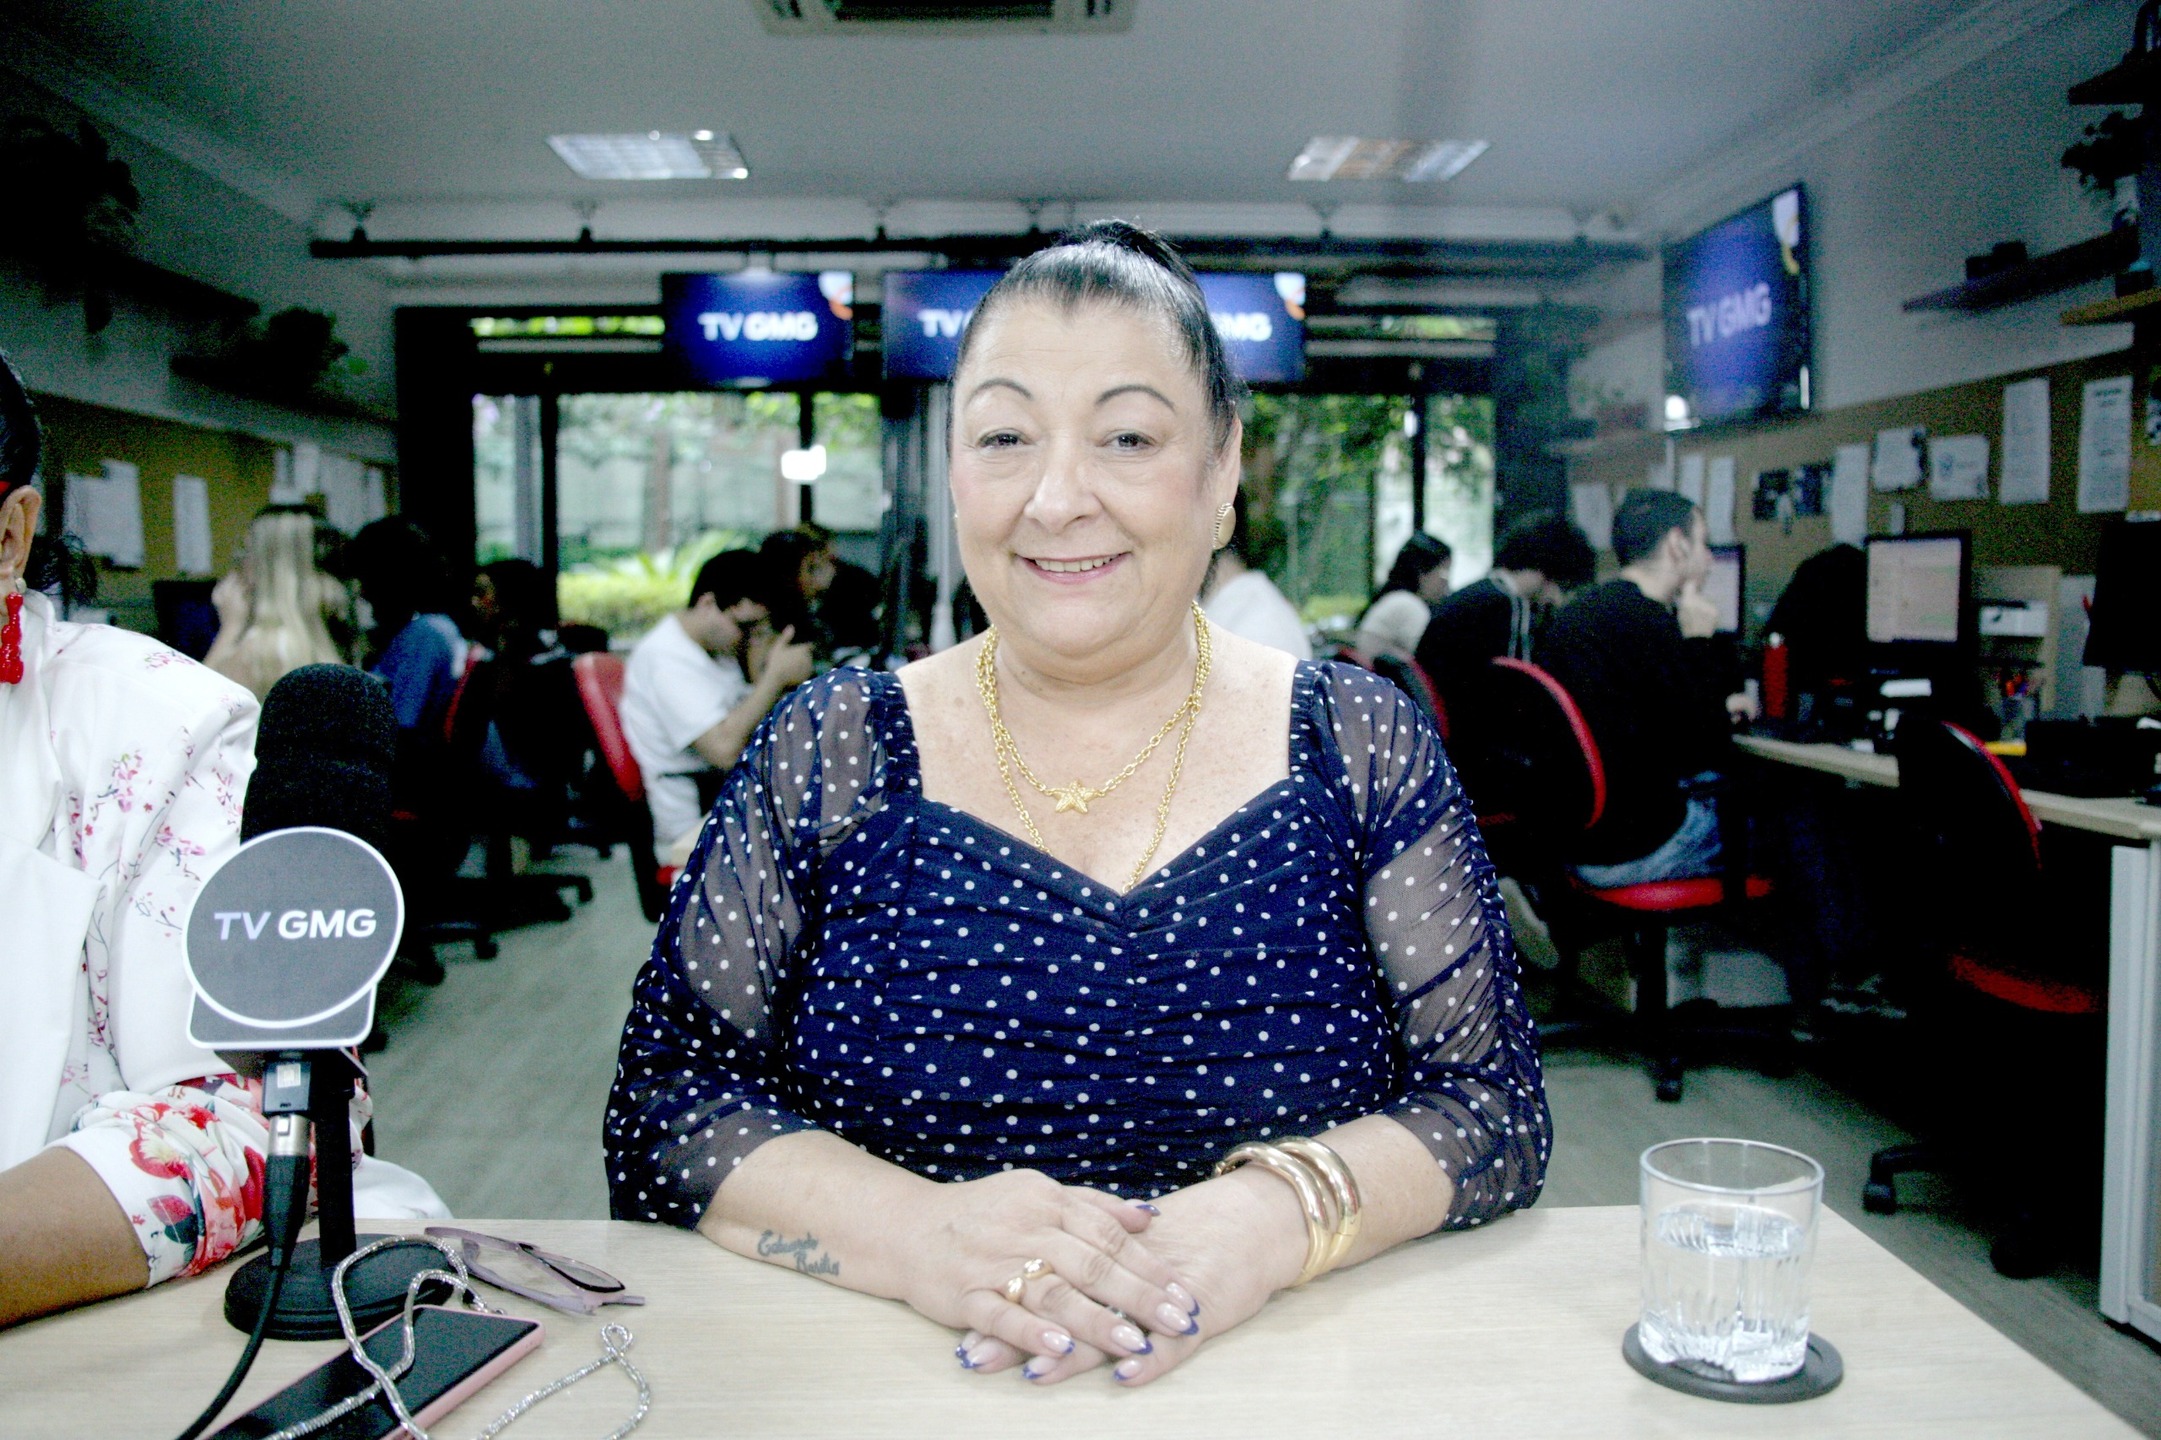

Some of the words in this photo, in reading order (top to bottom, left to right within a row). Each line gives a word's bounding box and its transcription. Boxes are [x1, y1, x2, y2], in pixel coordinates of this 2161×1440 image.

[699, 312, 744, 341] TV
[744, 311, 818, 341] GMG
[918, 309, 963, 337] TV
[1686, 303, 1717, 346] TV
[1718, 283, 1771, 337] GMG
[214, 911, 271, 940] TV
[278, 908, 377, 939] GMG
